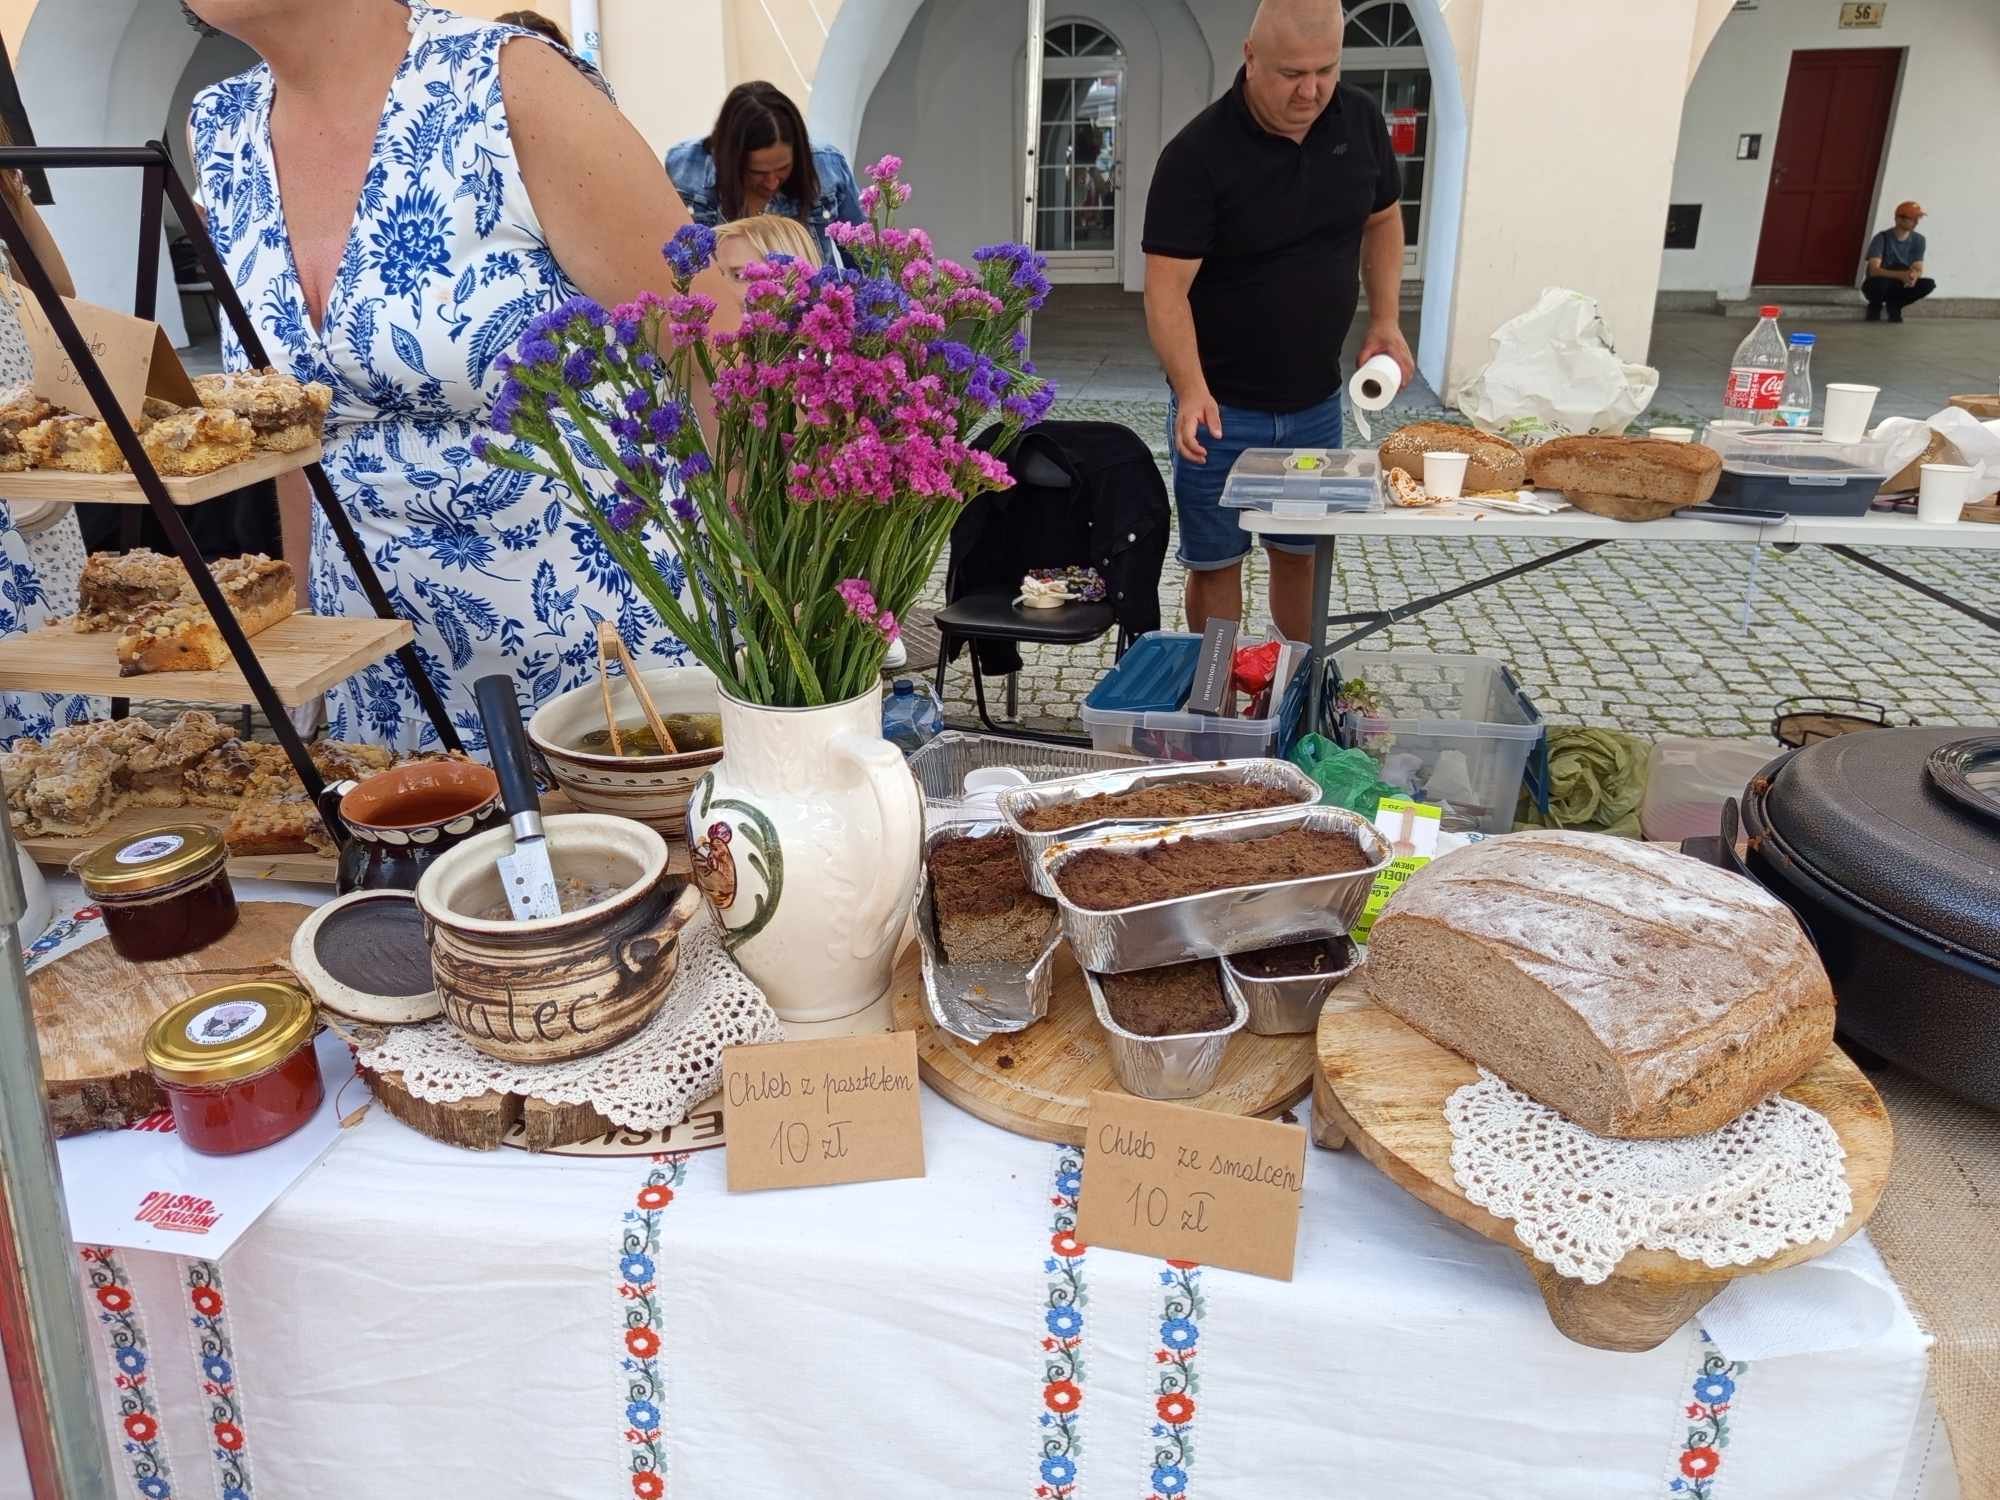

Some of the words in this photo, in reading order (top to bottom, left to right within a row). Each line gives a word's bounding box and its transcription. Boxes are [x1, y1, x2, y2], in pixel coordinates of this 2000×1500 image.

[1855, 4, 1871, 20] 56
[729, 1071, 792, 1107] Chleb
[800, 1076, 815, 1096] z
[770, 1121, 809, 1165] 10
[822, 1120, 853, 1159] zł
[1099, 1124, 1155, 1160] Chleb
[1178, 1146, 1201, 1170] ze
[1127, 1183, 1168, 1227] 10
[1181, 1191, 1216, 1233] zł
